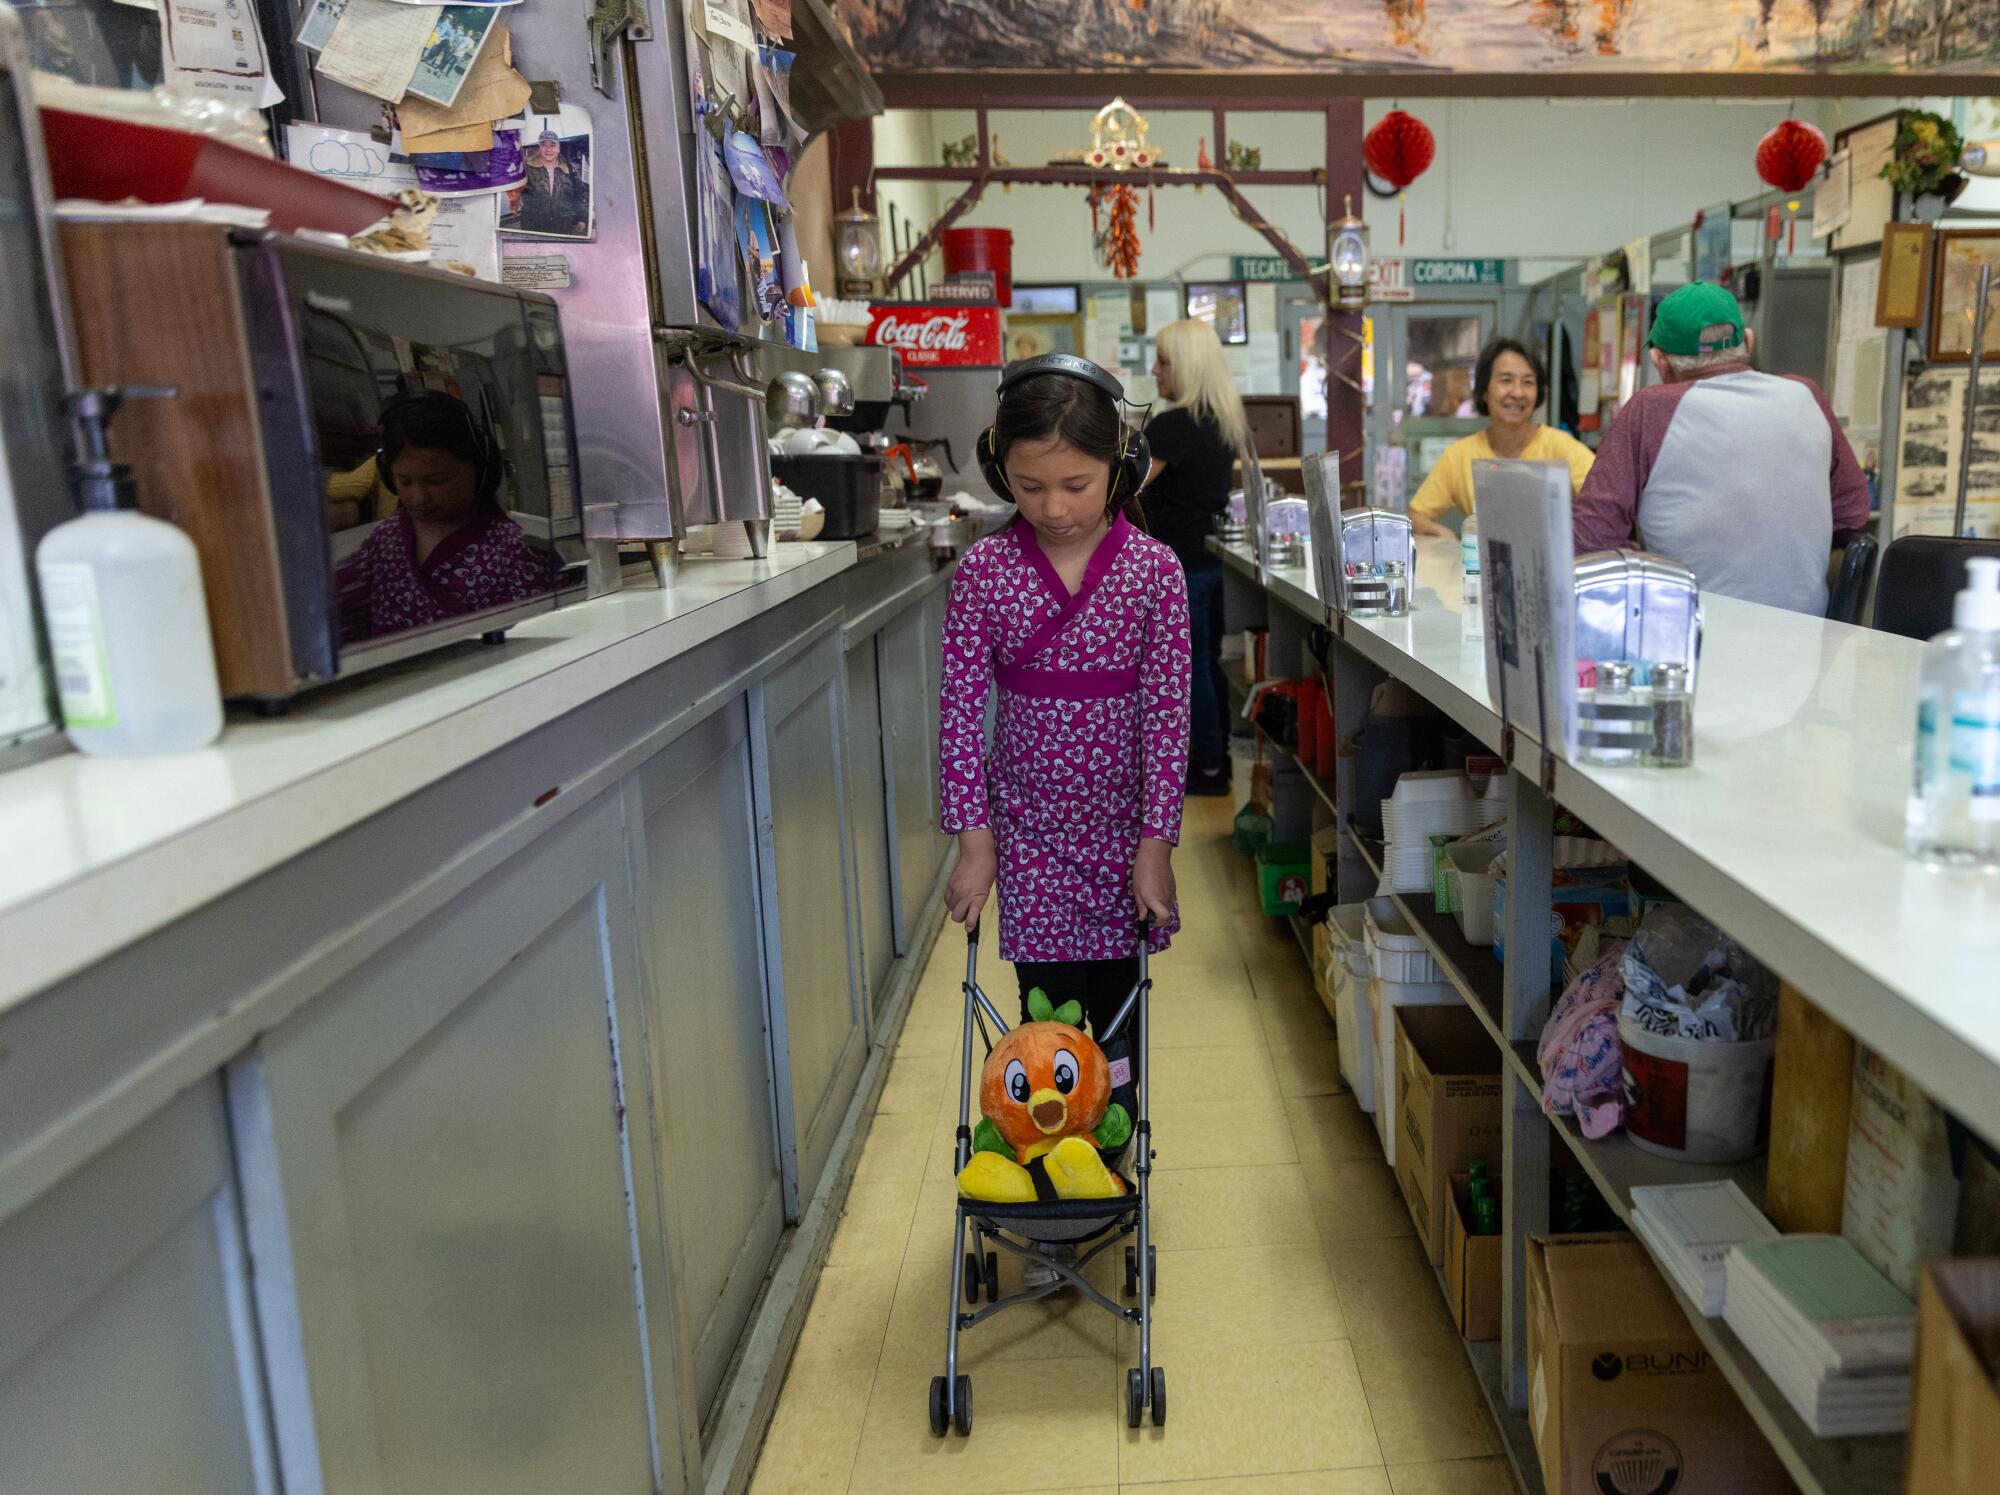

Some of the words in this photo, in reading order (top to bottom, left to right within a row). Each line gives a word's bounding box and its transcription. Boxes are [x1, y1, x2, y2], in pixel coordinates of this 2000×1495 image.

[1414, 261, 1478, 282] CORONA
[929, 285, 991, 299] RESERVED
[876, 315, 968, 350] Coca-Cola
